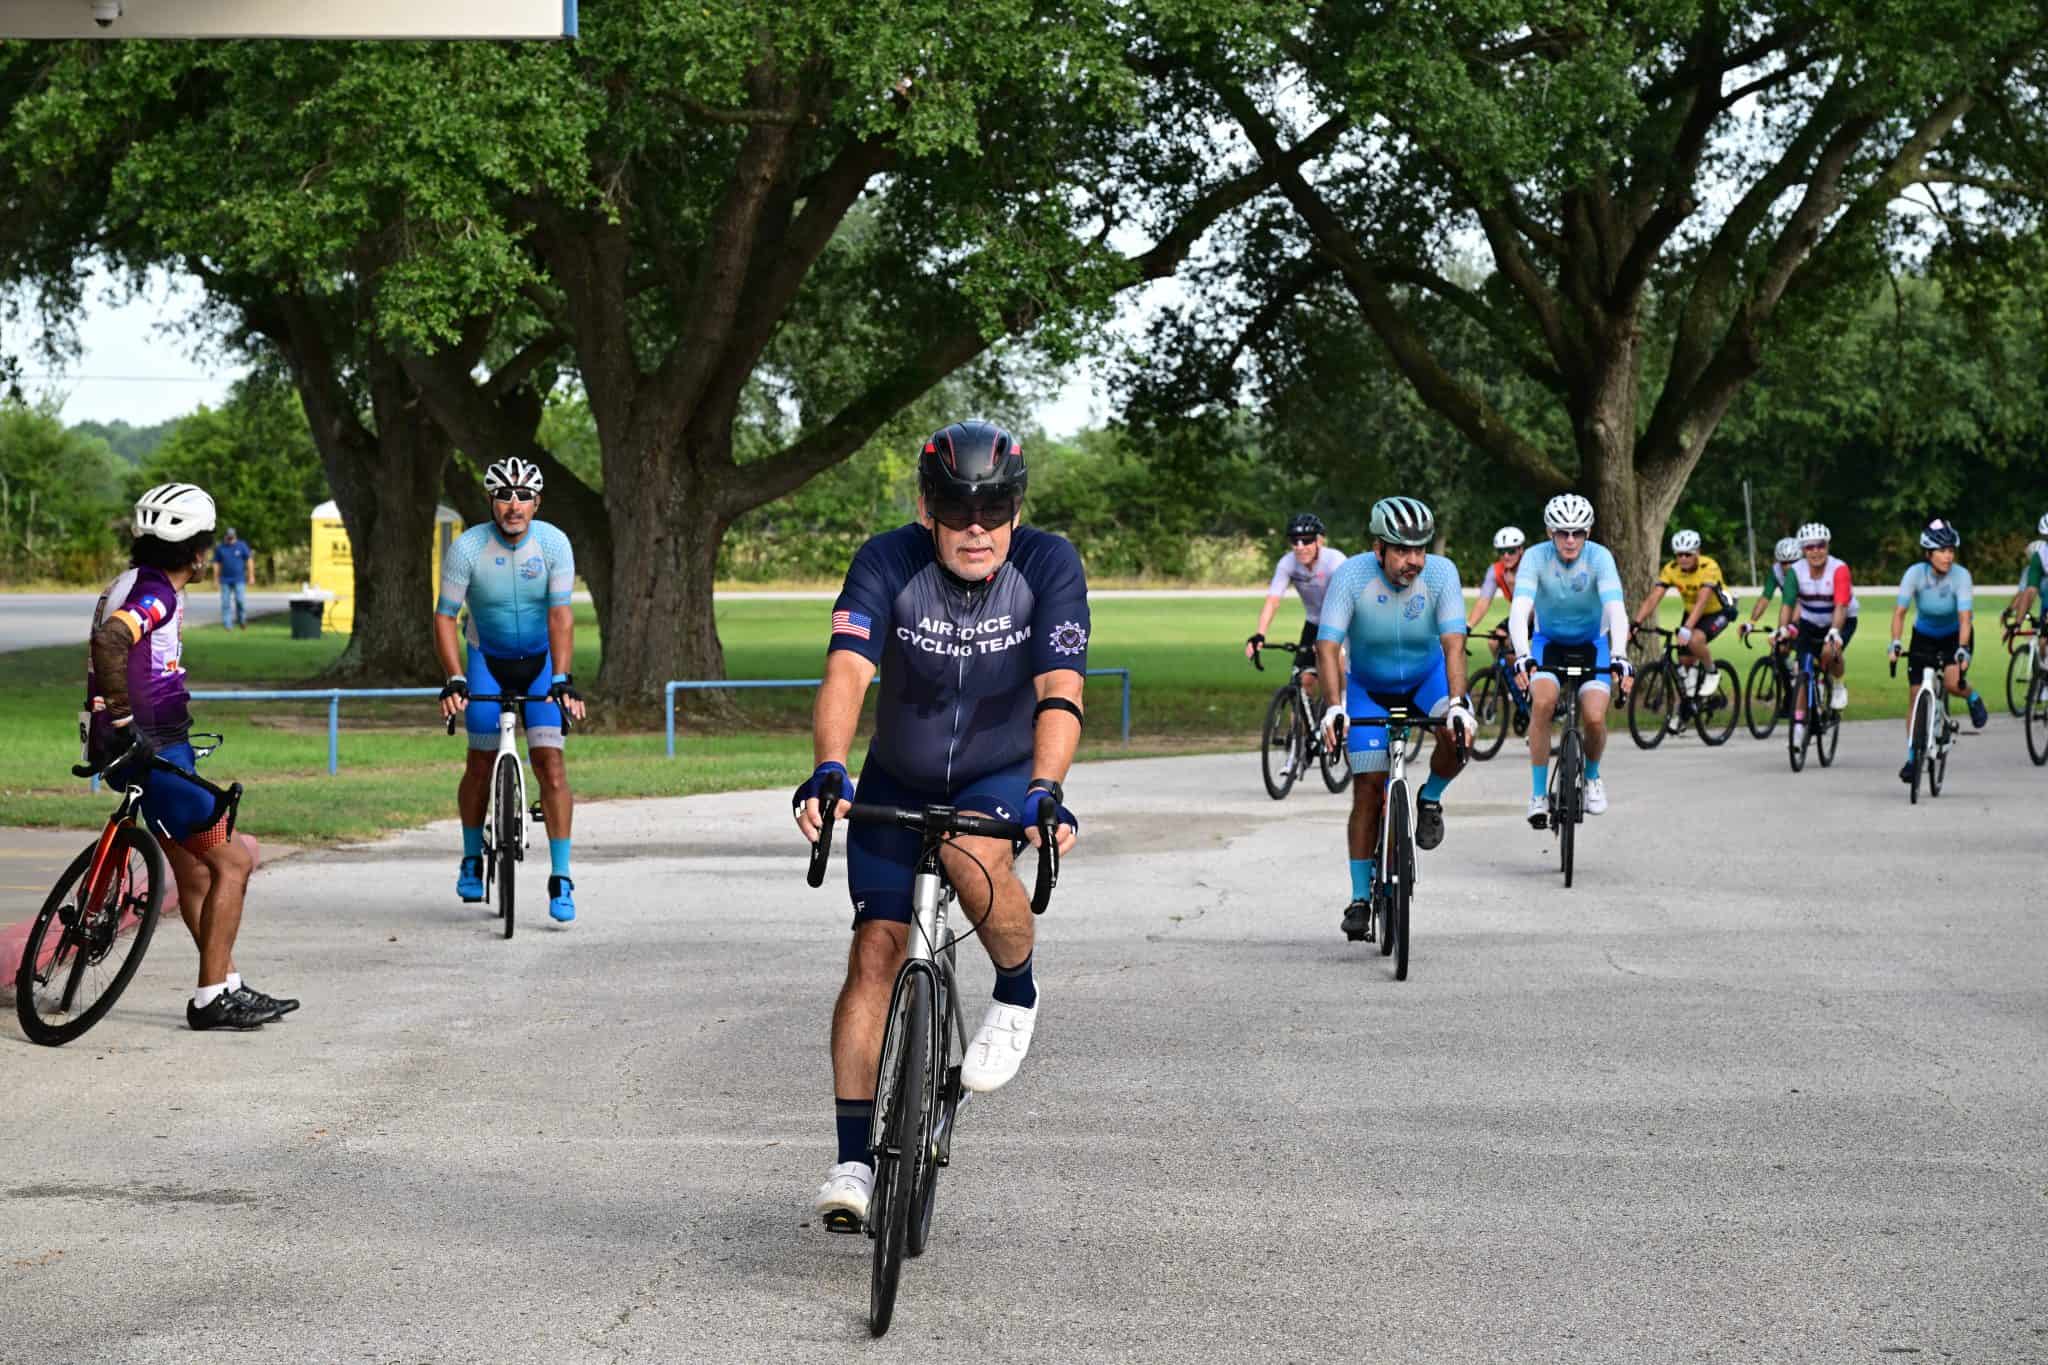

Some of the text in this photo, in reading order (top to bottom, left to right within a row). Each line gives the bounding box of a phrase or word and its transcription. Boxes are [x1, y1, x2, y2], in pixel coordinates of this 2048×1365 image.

[918, 615, 1012, 641] AIR OCE
[976, 625, 1032, 655] TEAM
